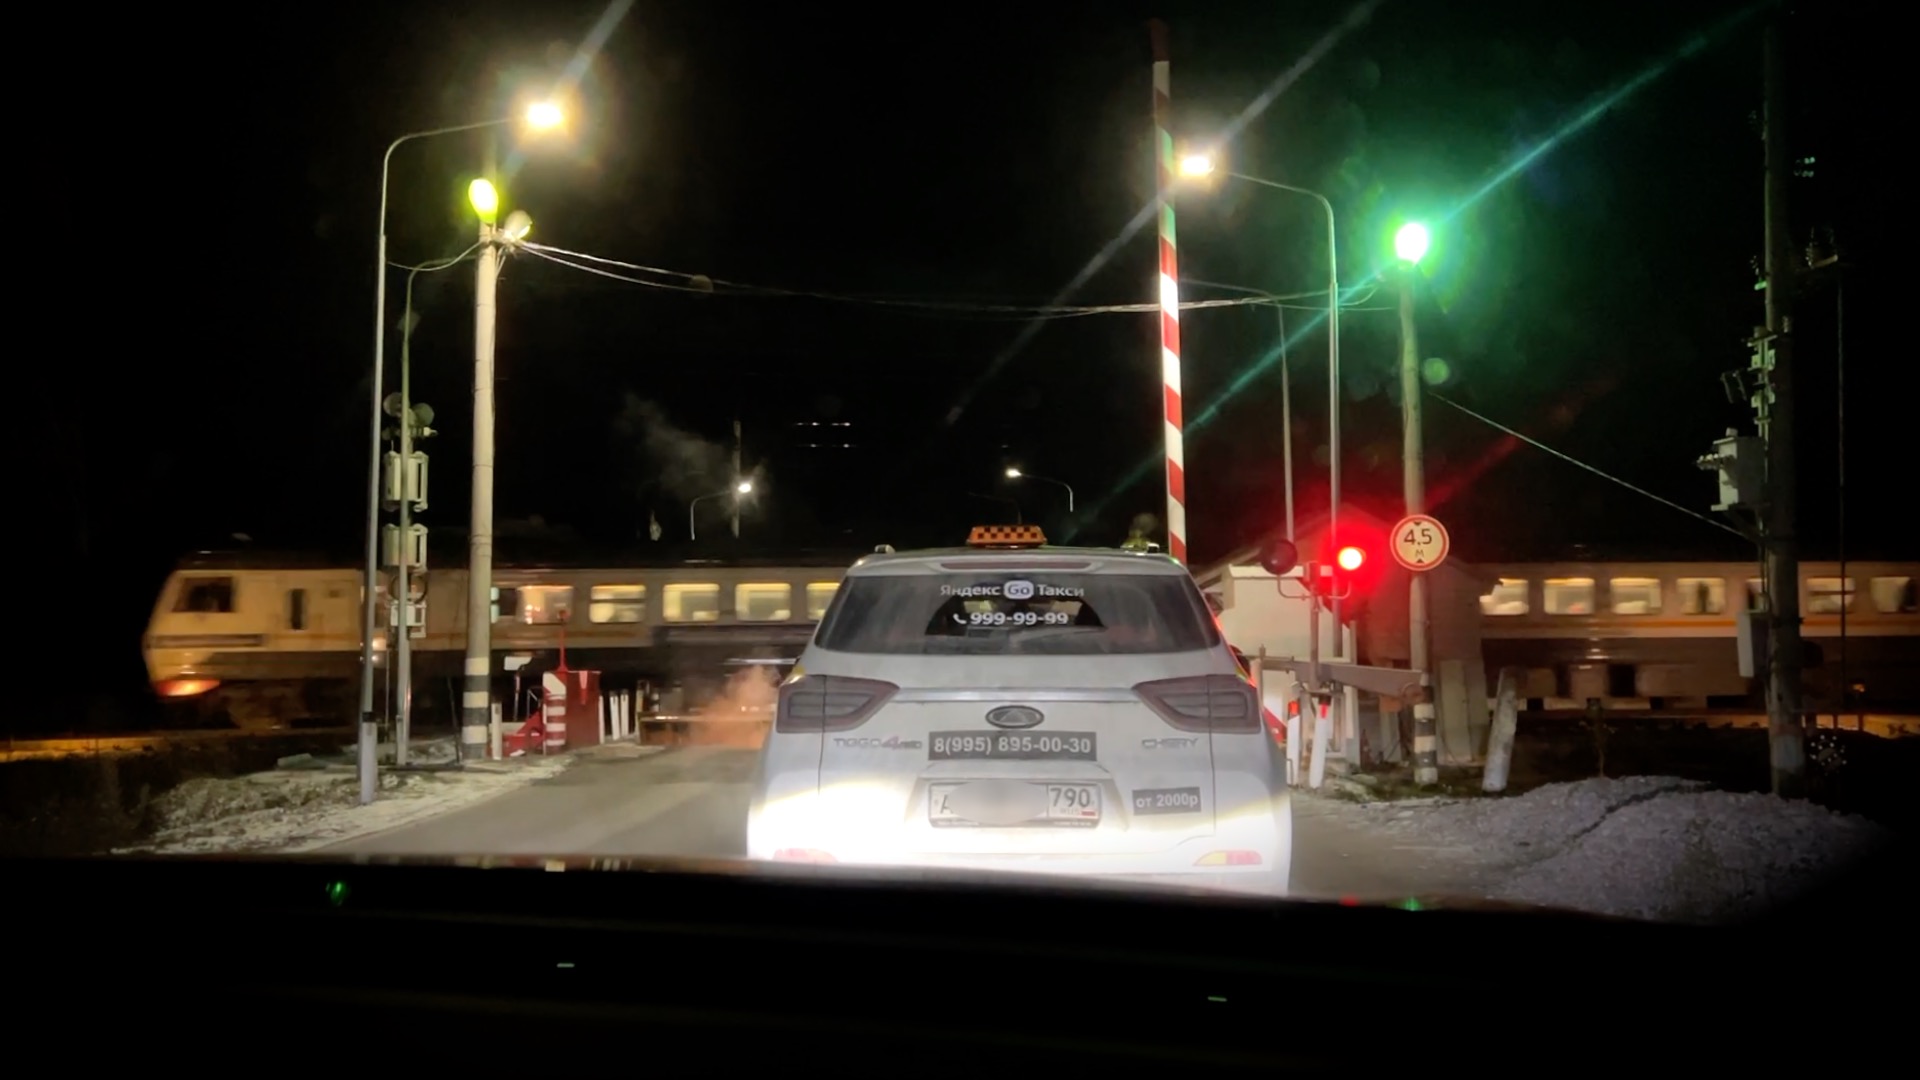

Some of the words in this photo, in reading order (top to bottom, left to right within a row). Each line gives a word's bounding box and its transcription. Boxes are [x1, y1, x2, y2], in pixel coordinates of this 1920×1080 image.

[940, 584, 1001, 597] Яндекс
[1008, 584, 1031, 596] Go
[1037, 583, 1085, 597] Такси
[970, 612, 1069, 626] 999-99-99
[934, 736, 992, 755] 8(995)
[998, 736, 1091, 753] 895-00-30
[1050, 787, 1091, 808] 790
[1136, 799, 1152, 809] от
